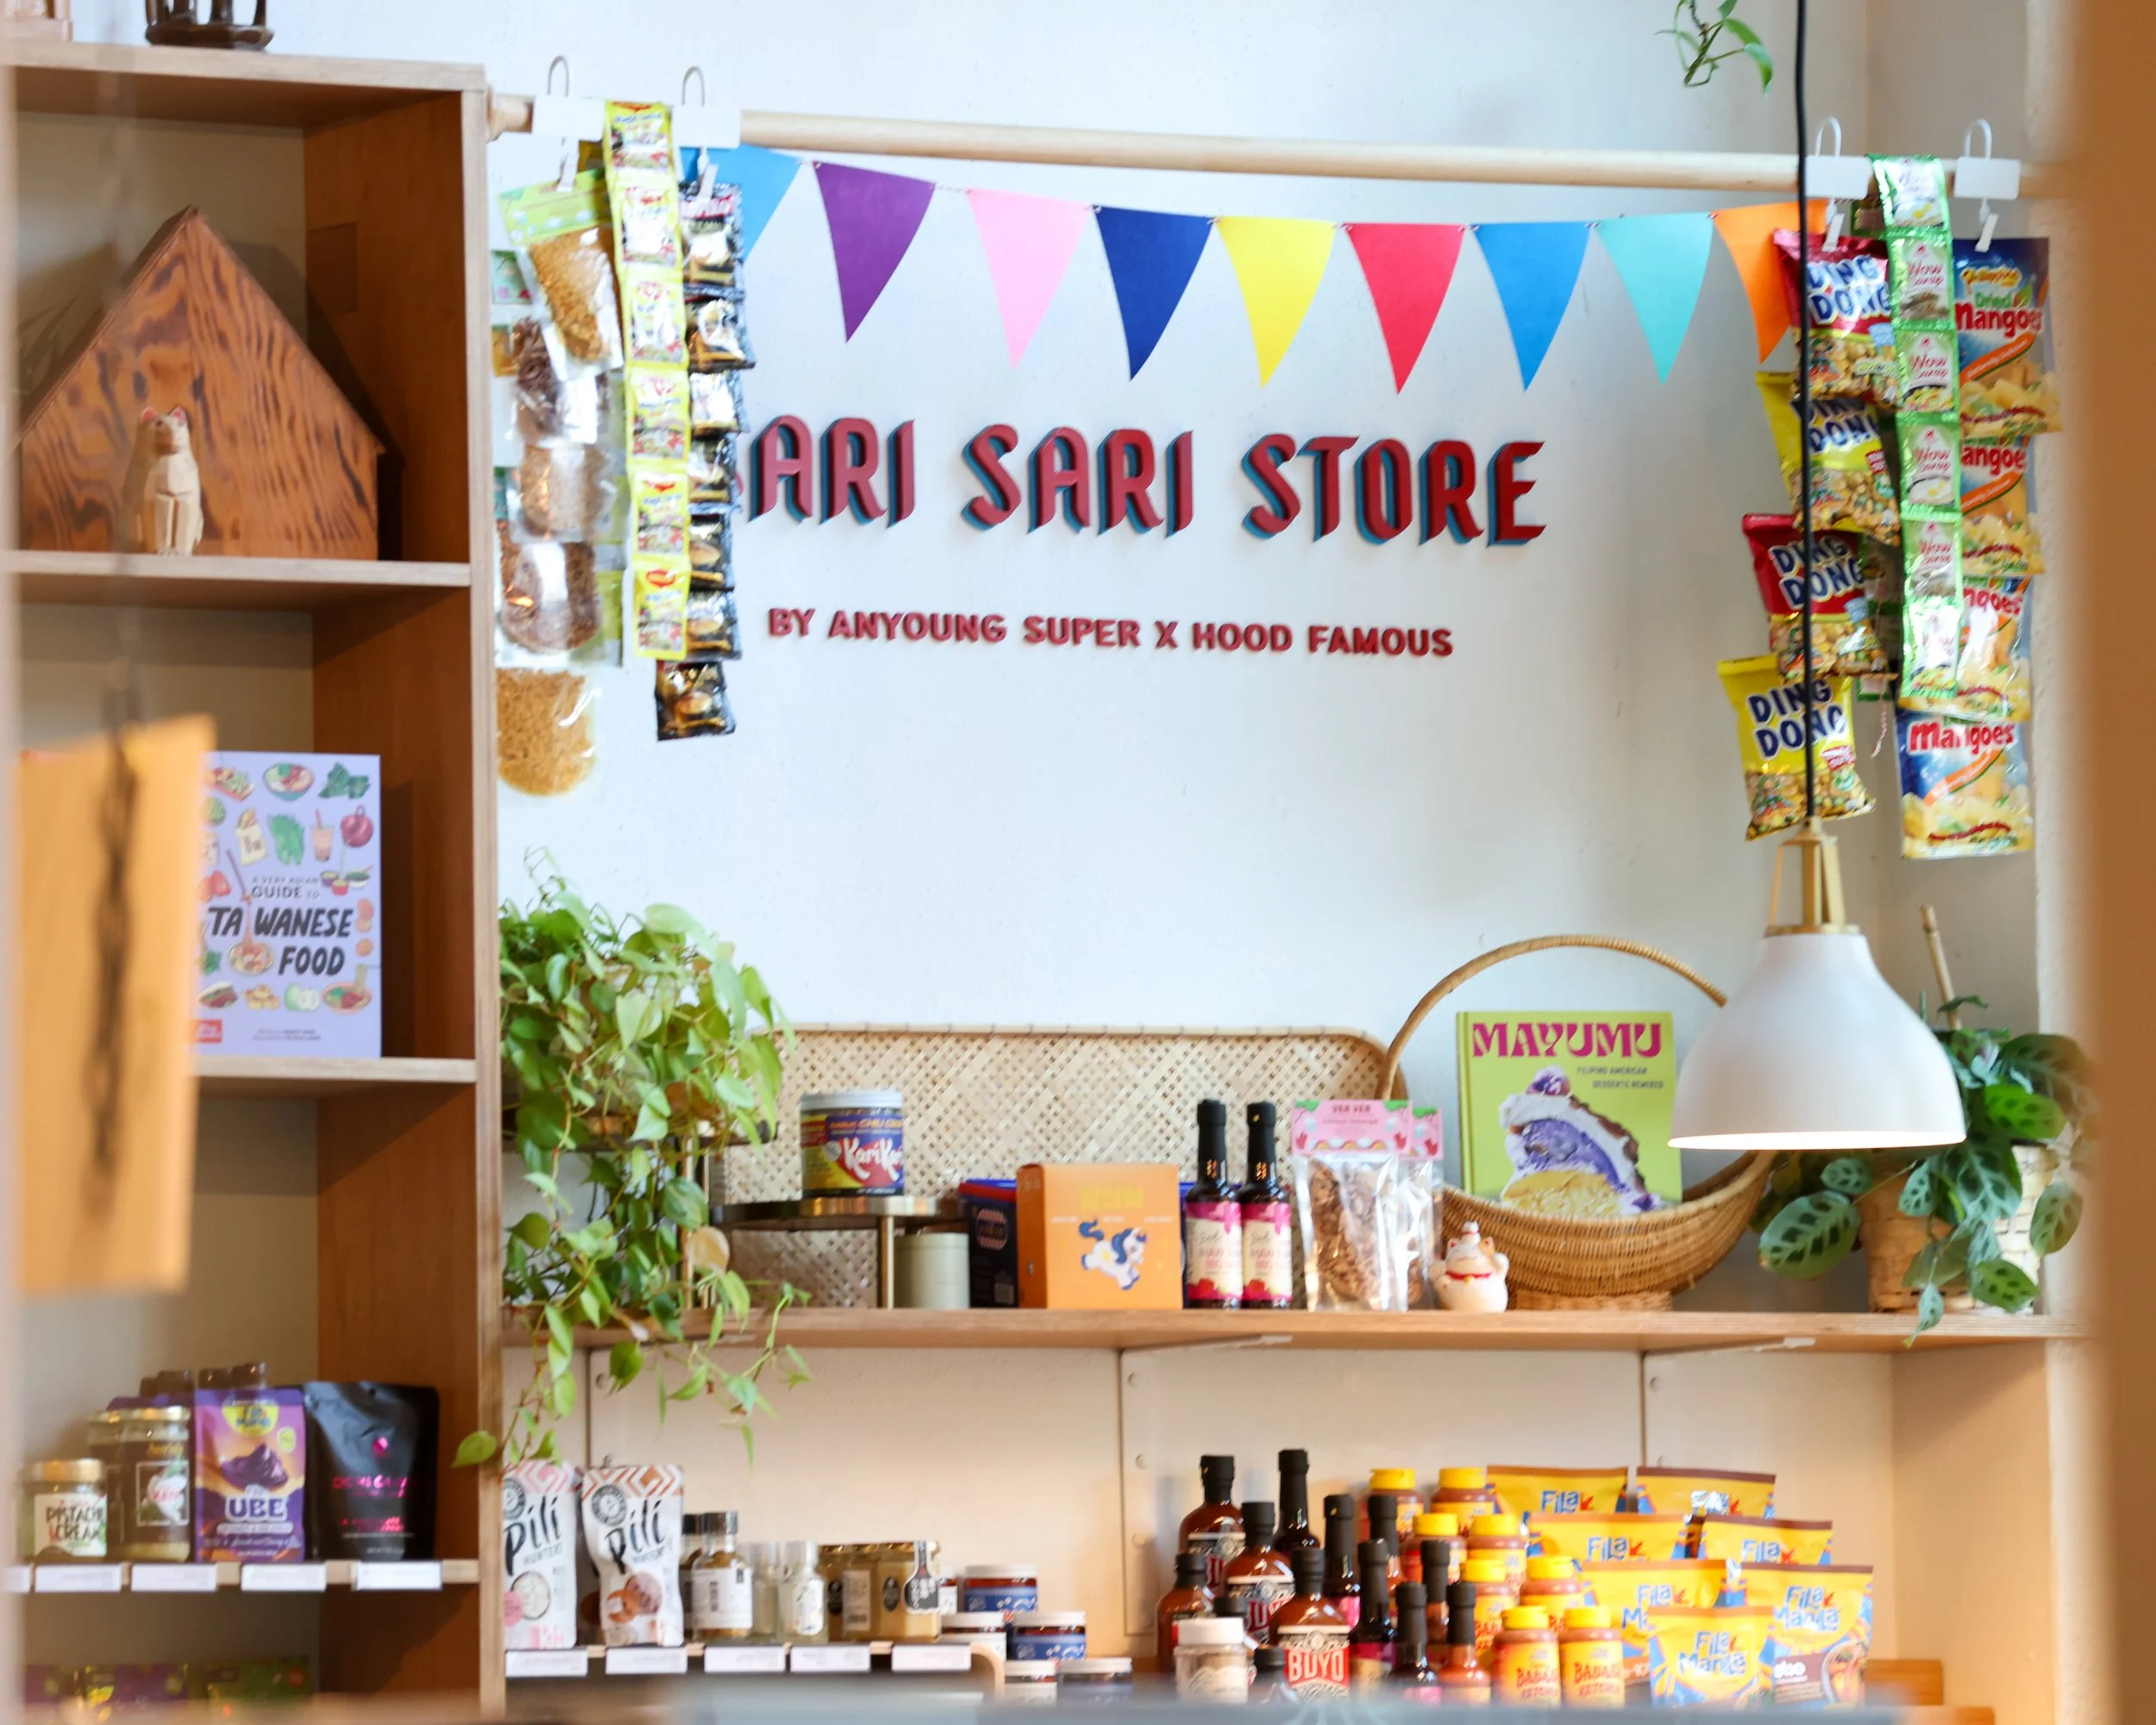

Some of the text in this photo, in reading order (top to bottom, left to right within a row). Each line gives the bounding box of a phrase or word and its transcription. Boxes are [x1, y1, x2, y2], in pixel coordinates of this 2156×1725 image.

[739, 414, 1548, 548] ARI SARI STORE
[768, 607, 1454, 657] BY ANYOUNG SUPER X HOOD FAMOUS
[1909, 722, 2015, 756] Mangoes
[252, 886, 303, 898] GUIDE
[279, 945, 346, 975] FOOD
[1472, 1022, 1662, 1059] MAYUMU
[229, 1497, 285, 1518] UBE
[1787, 1586, 1824, 1609] Fila
[1695, 1631, 1730, 1654] Fila
